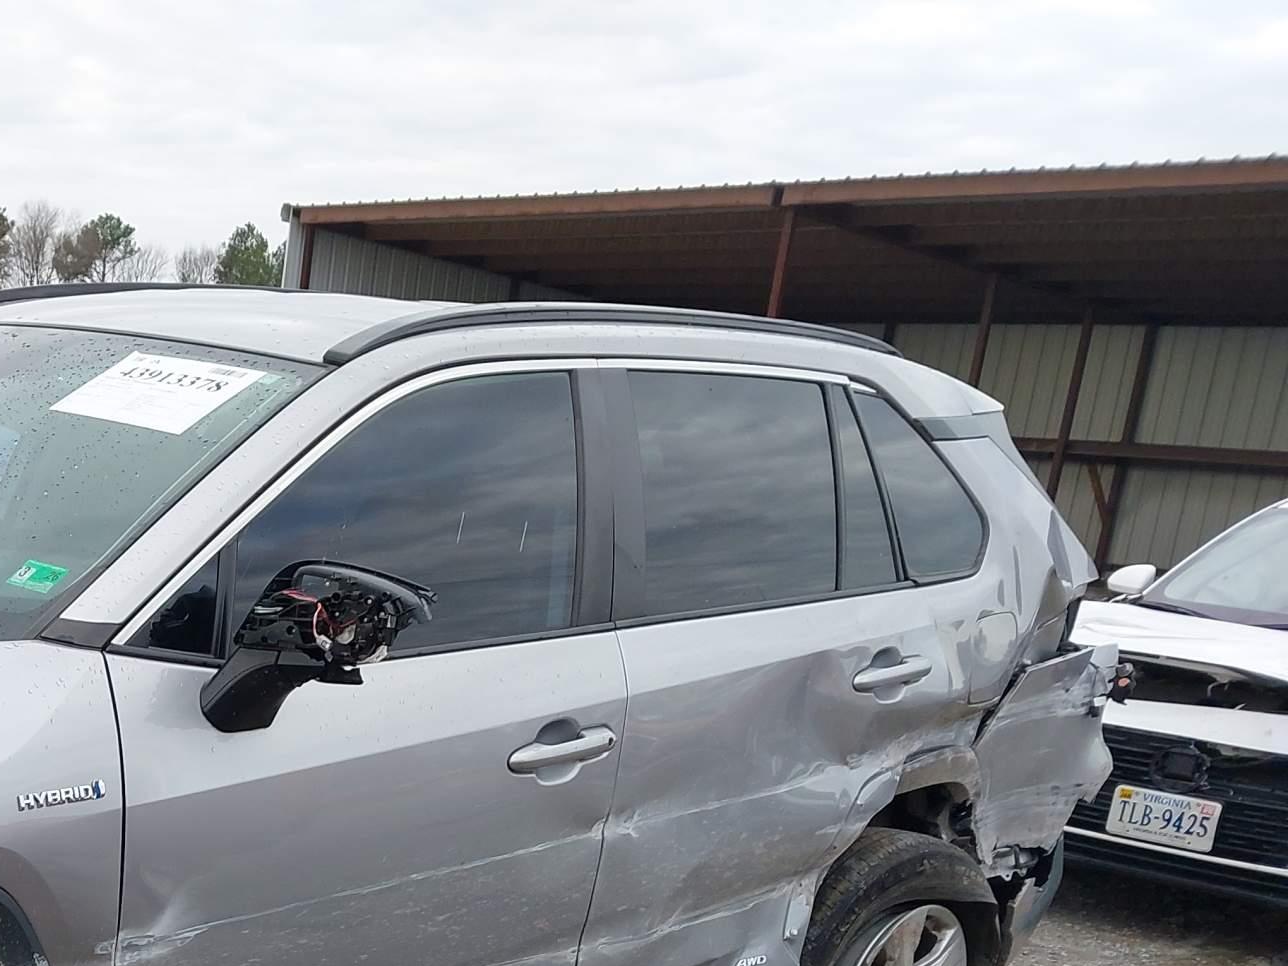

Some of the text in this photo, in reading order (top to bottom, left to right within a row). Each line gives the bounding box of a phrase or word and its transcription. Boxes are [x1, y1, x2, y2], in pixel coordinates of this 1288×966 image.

[120, 366, 229, 392] 43913378
[16, 784, 92, 812] HYBRID
[1143, 793, 1192, 811] VIRGINIA
[1117, 800, 1211, 838] TLB-9425
